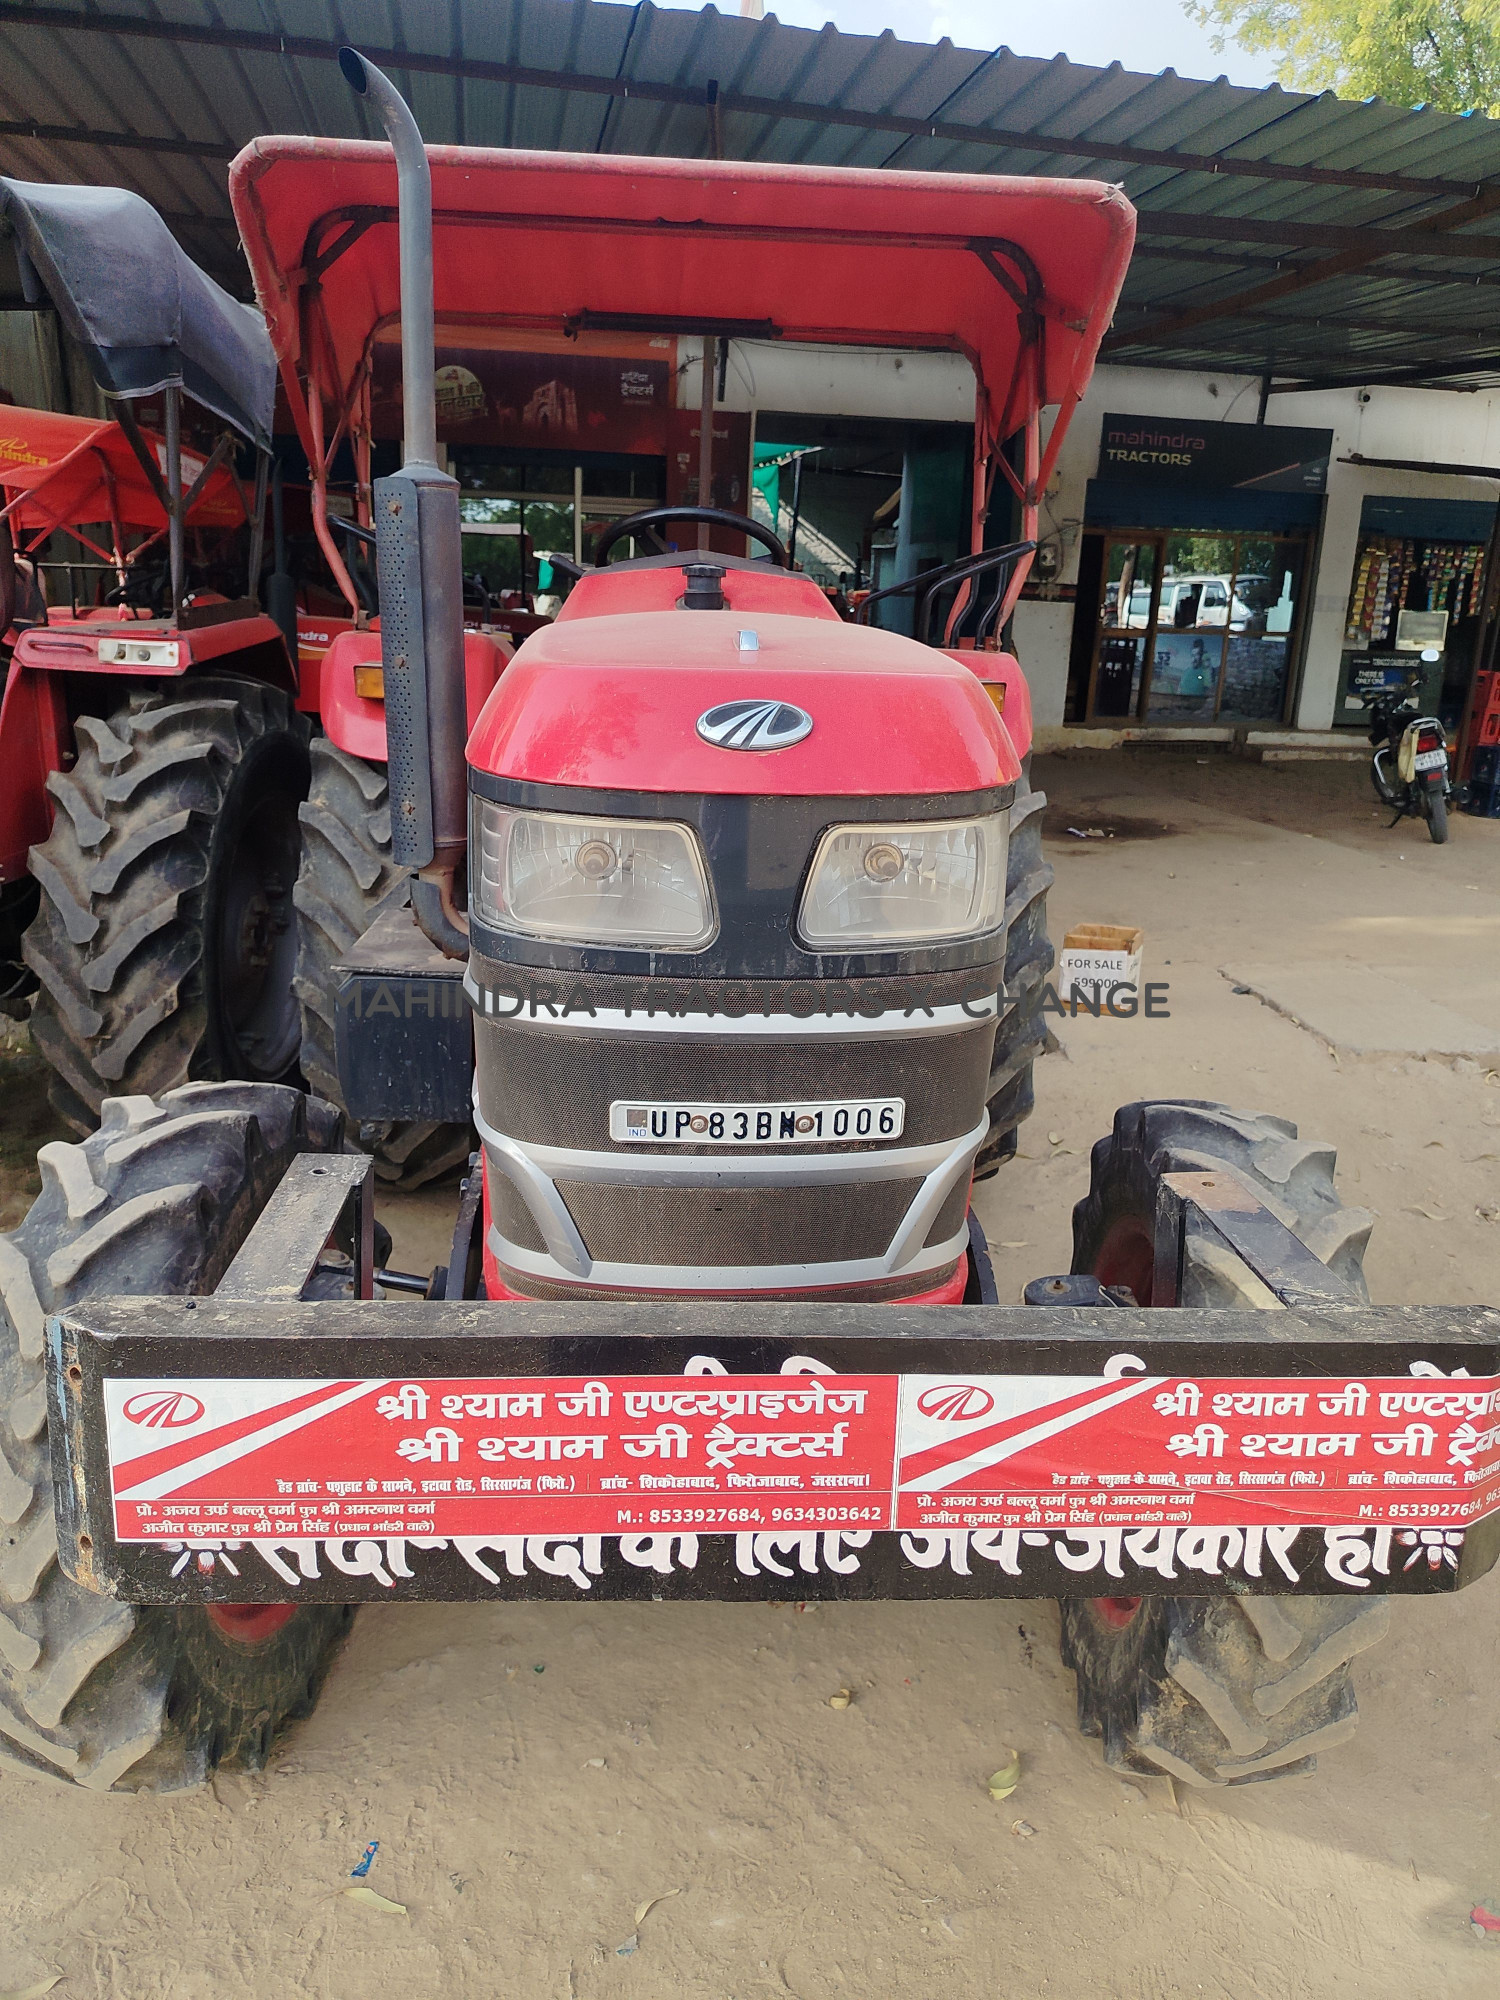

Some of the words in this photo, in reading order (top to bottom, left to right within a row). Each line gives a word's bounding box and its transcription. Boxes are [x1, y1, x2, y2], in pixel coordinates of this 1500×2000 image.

[1108, 430, 1205, 450] mahindra
[1107, 449, 1192, 465] TRACTORS
[1067, 958, 1091, 969] FOR
[1094, 959, 1123, 971] SALE
[628, 1129, 647, 1137] IND
[374, 1385, 430, 1420] श्री
[441, 1393, 546, 1419] श्याम
[555, 1381, 613, 1416] जी
[623, 1380, 868, 1420] एण्टरप्राइजेज
[1151, 1383, 1203, 1416] श्री
[1212, 1393, 1309, 1416] श्याम
[1317, 1383, 1370, 1416] जी
[395, 1427, 464, 1462] श्री
[478, 1435, 608, 1461] श्याम
[620, 1422, 692, 1458] जी
[704, 1422, 849, 1469] ट्रैक्टर्स
[1165, 1424, 1229, 1458] श्री
[1240, 1434, 1361, 1457] श्याम
[1371, 1423, 1438, 1456] जी
[365, 1478, 378, 1492] के
[421, 1480, 451, 1493] इटावा
[1184, 1474, 1213, 1486] इटावा
[941, 1497, 977, 1506] अजय
[980, 1494, 1004, 1506] उर्फ
[1007, 1497, 1039, 1509] बल्लू
[1040, 1493, 1067, 1506] वर्मा
[1090, 1493, 1107, 1505] श्री
[1110, 1495, 1167, 1505] अमरनाथ
[1170, 1493, 1196, 1504] वर्मा
[1357, 1505, 1383, 1518] M.:
[1388, 1498, 1485, 1519] 8533927684,
[162, 1506, 200, 1516] अजय
[204, 1502, 229, 1515] उर्फ
[232, 1506, 268, 1519] बल्लू
[268, 1502, 296, 1515] वर्मा
[299, 1507, 317, 1518] पुत्र
[321, 1502, 340, 1515] श्री
[344, 1504, 404, 1515] अमरनाथ
[408, 1501, 435, 1514] वर्मा
[618, 1510, 642, 1523] M.:
[650, 1508, 765, 1524] 8533927684,
[772, 1507, 880, 1522] 9634303642
[920, 1511, 960, 1523] अजीत
[963, 1514, 1002, 1526] कुमार
[1024, 1510, 1042, 1522] श्री
[1044, 1510, 1066, 1523] प्रेम
[1069, 1508, 1096, 1522] सिंह
[142, 1520, 184, 1533] अजीत
[188, 1523, 229, 1536] कुमार
[231, 1524, 249, 1535] पुत्र
[253, 1520, 272, 1532] श्री
[275, 1520, 298, 1533] प्रेम
[301, 1519, 330, 1532] सिंह
